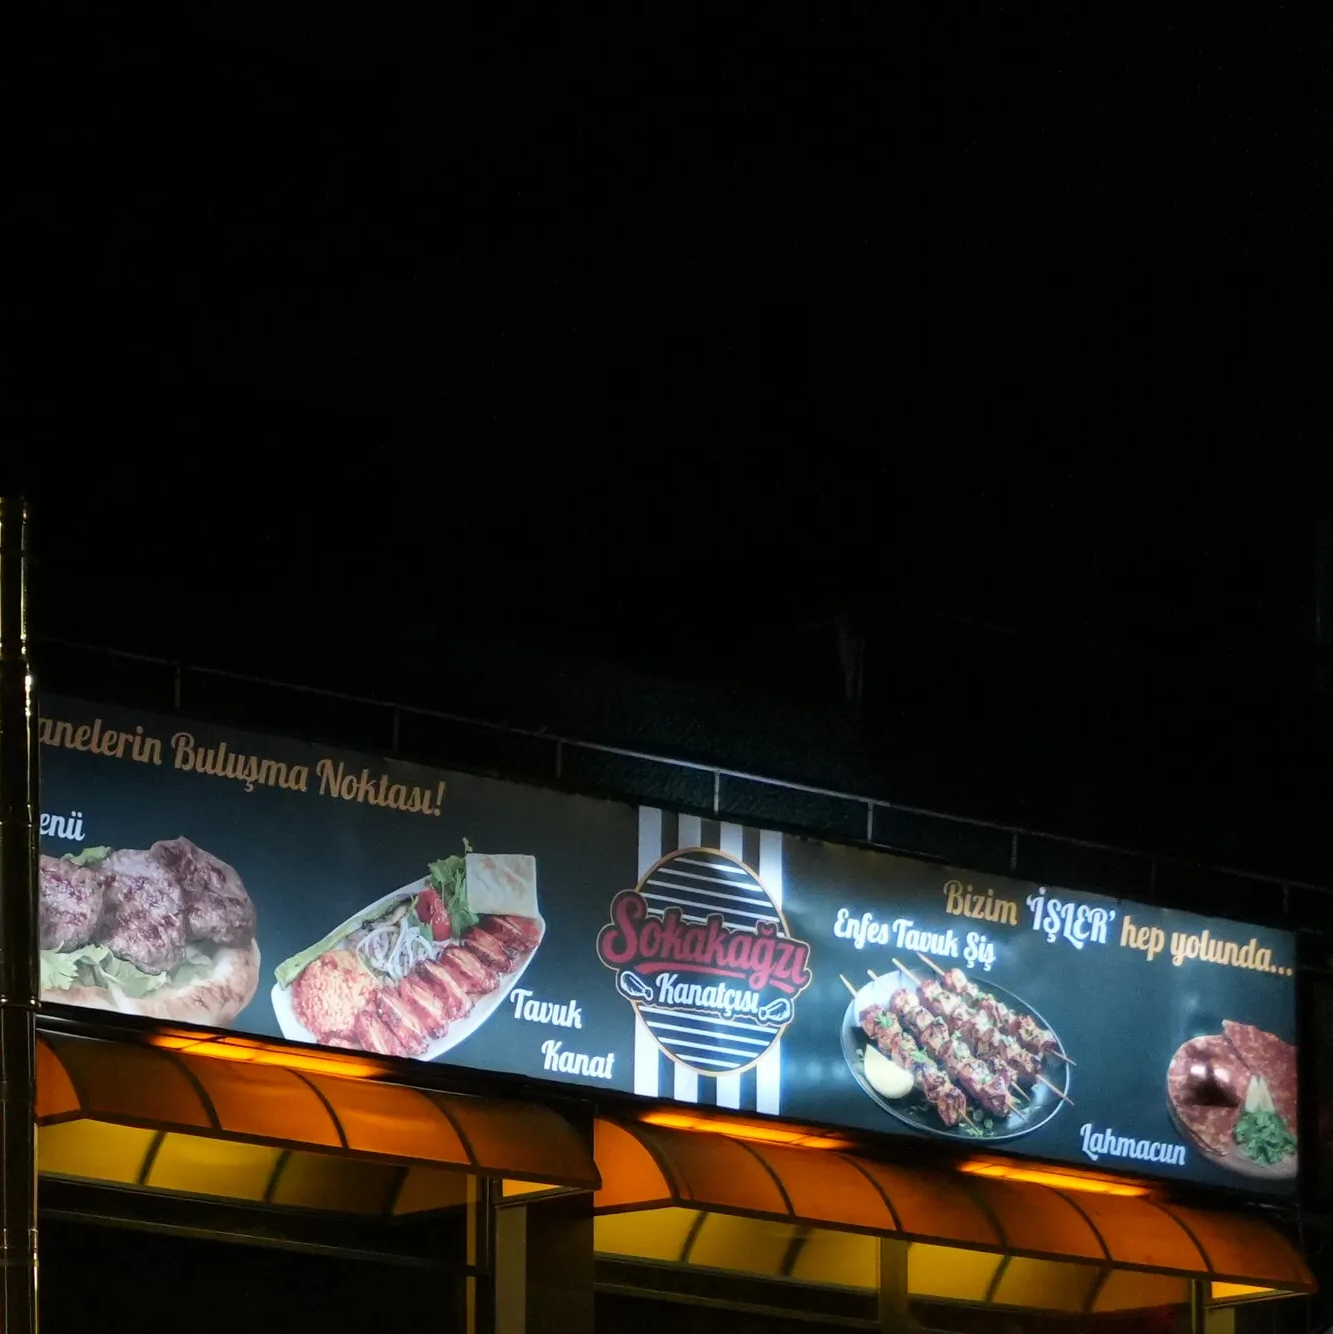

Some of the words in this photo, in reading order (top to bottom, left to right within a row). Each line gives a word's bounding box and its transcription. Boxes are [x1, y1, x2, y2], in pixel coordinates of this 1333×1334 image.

[170, 731, 309, 792] Buluşma
[315, 758, 446, 817] Noktası!
[601, 896, 807, 990] Sokakağzı
[833, 908, 889, 950] Enfes
[891, 918, 959, 958] Tavuk
[963, 931, 997, 972] Şiş
[943, 879, 1019, 926] Bizim
[1119, 915, 1166, 962] hep
[1169, 929, 1294, 978] yolunda...
[510, 987, 584, 1030] Tavuk
[655, 972, 760, 1017] Kanatçısı
[540, 1039, 615, 1080] Kanat
[1079, 1122, 1187, 1167] Lahmacun
